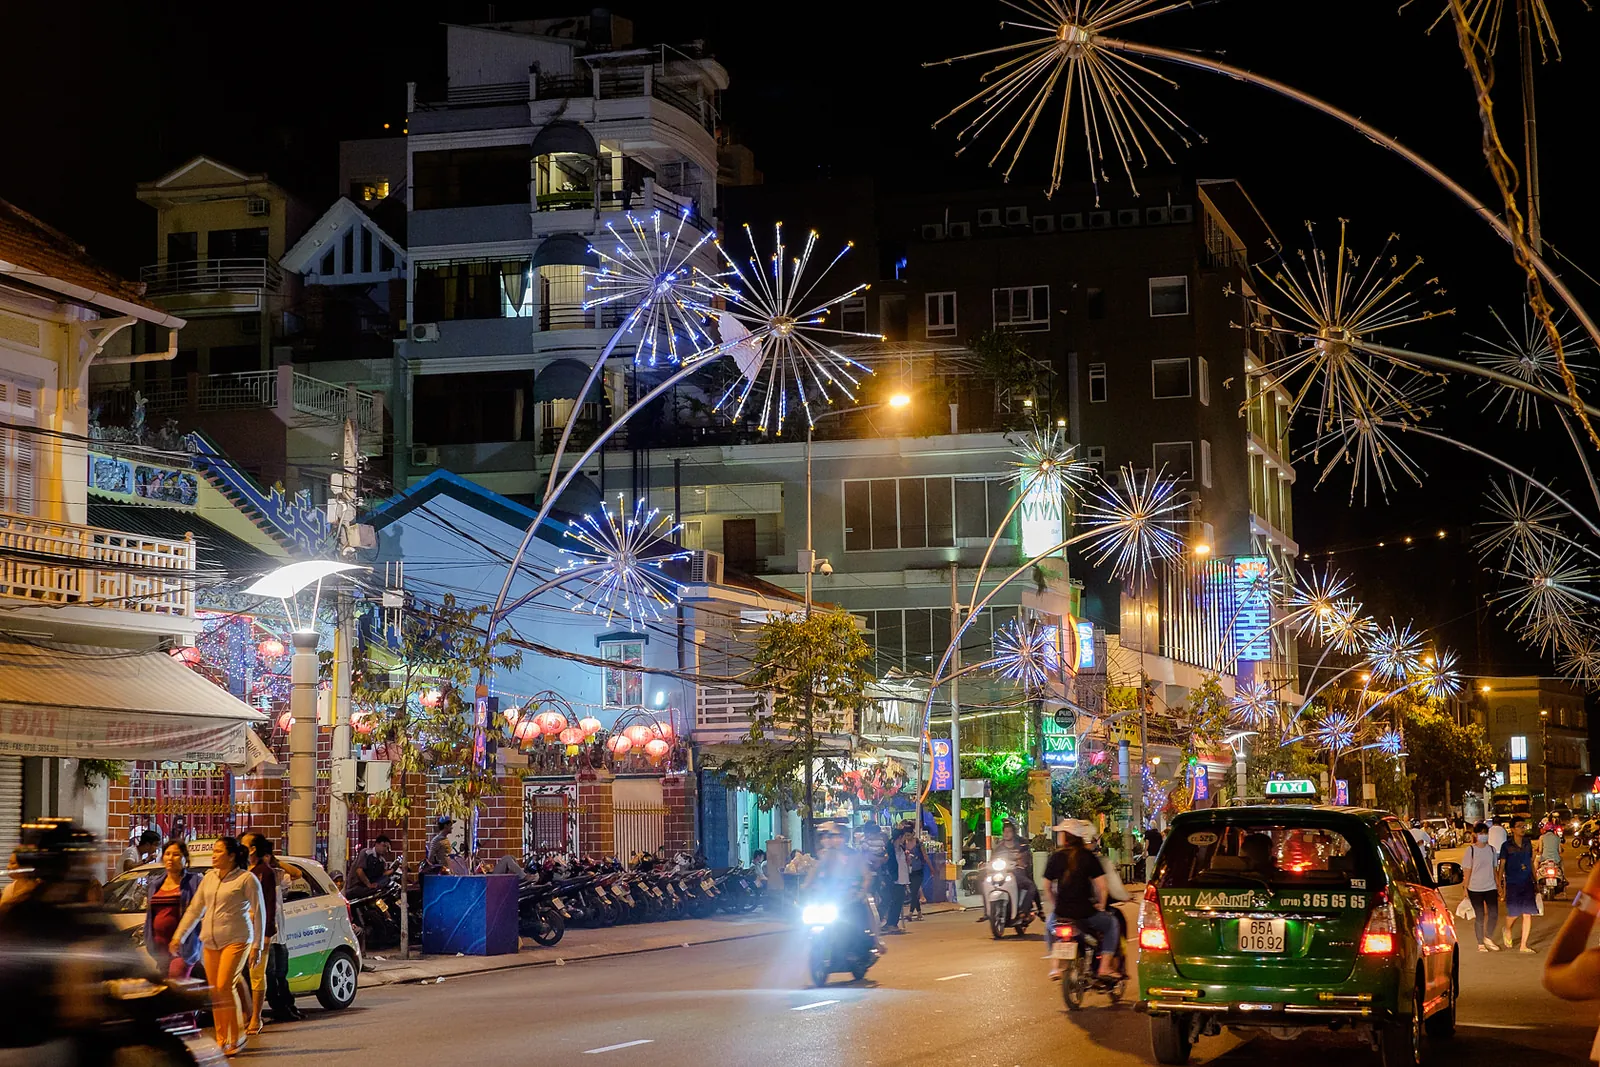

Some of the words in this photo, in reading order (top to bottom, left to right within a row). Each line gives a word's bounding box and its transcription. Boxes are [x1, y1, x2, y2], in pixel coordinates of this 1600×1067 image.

[1022, 502, 1060, 521] VIVA
[935, 759, 950, 790] Tiger
[1274, 782, 1303, 793] TAXI
[1162, 895, 1191, 906] TAXI
[1331, 894, 1346, 908] 65
[1350, 895, 1365, 909] 65
[1250, 921, 1273, 935] 65A
[1241, 935, 1283, 950] 016.92
